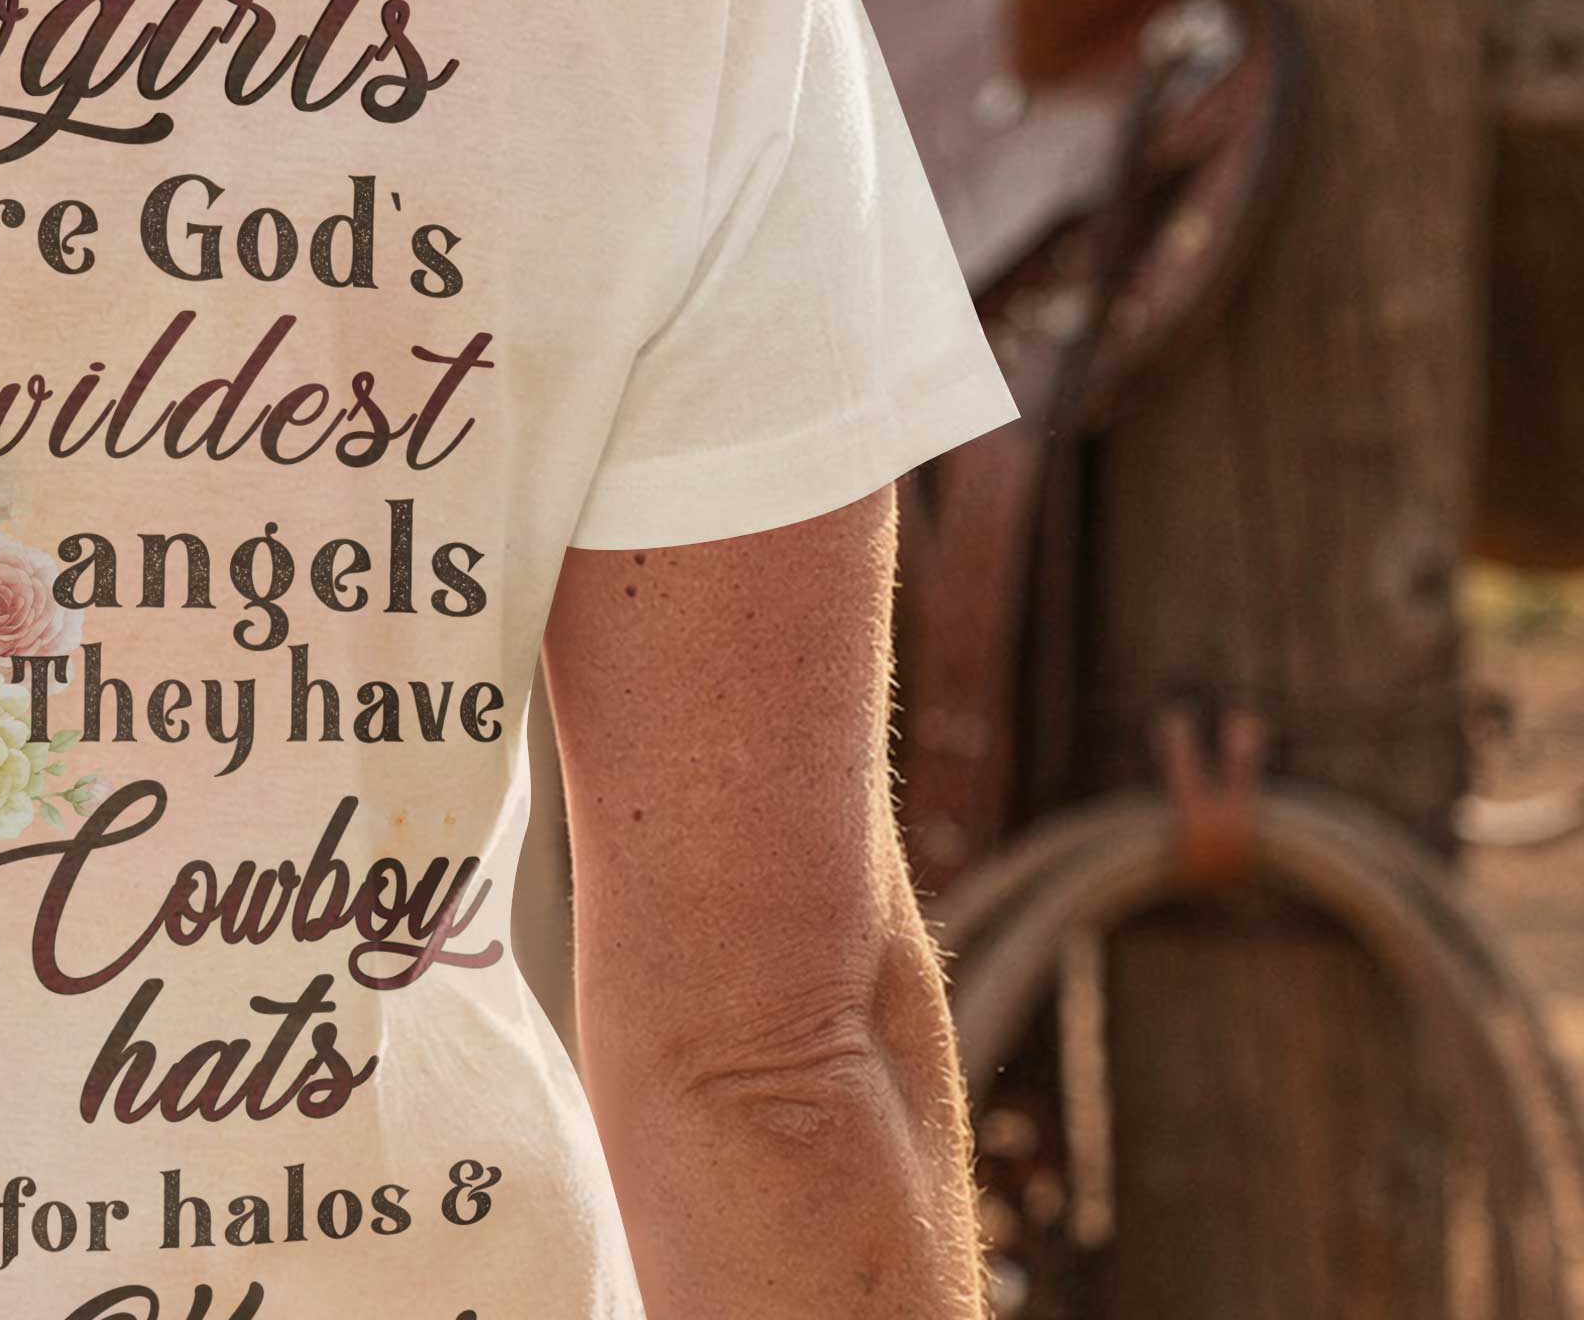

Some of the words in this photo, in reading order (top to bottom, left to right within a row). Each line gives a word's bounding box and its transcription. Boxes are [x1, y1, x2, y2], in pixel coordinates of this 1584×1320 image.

[139, 174, 465, 299] God's
[51, 498, 489, 652] angels
[11, 641, 256, 777] They
[288, 641, 504, 744] have
[79, 973, 382, 1126] hats
[162, 1162, 413, 1252] halos
[439, 1158, 503, 1226] &
